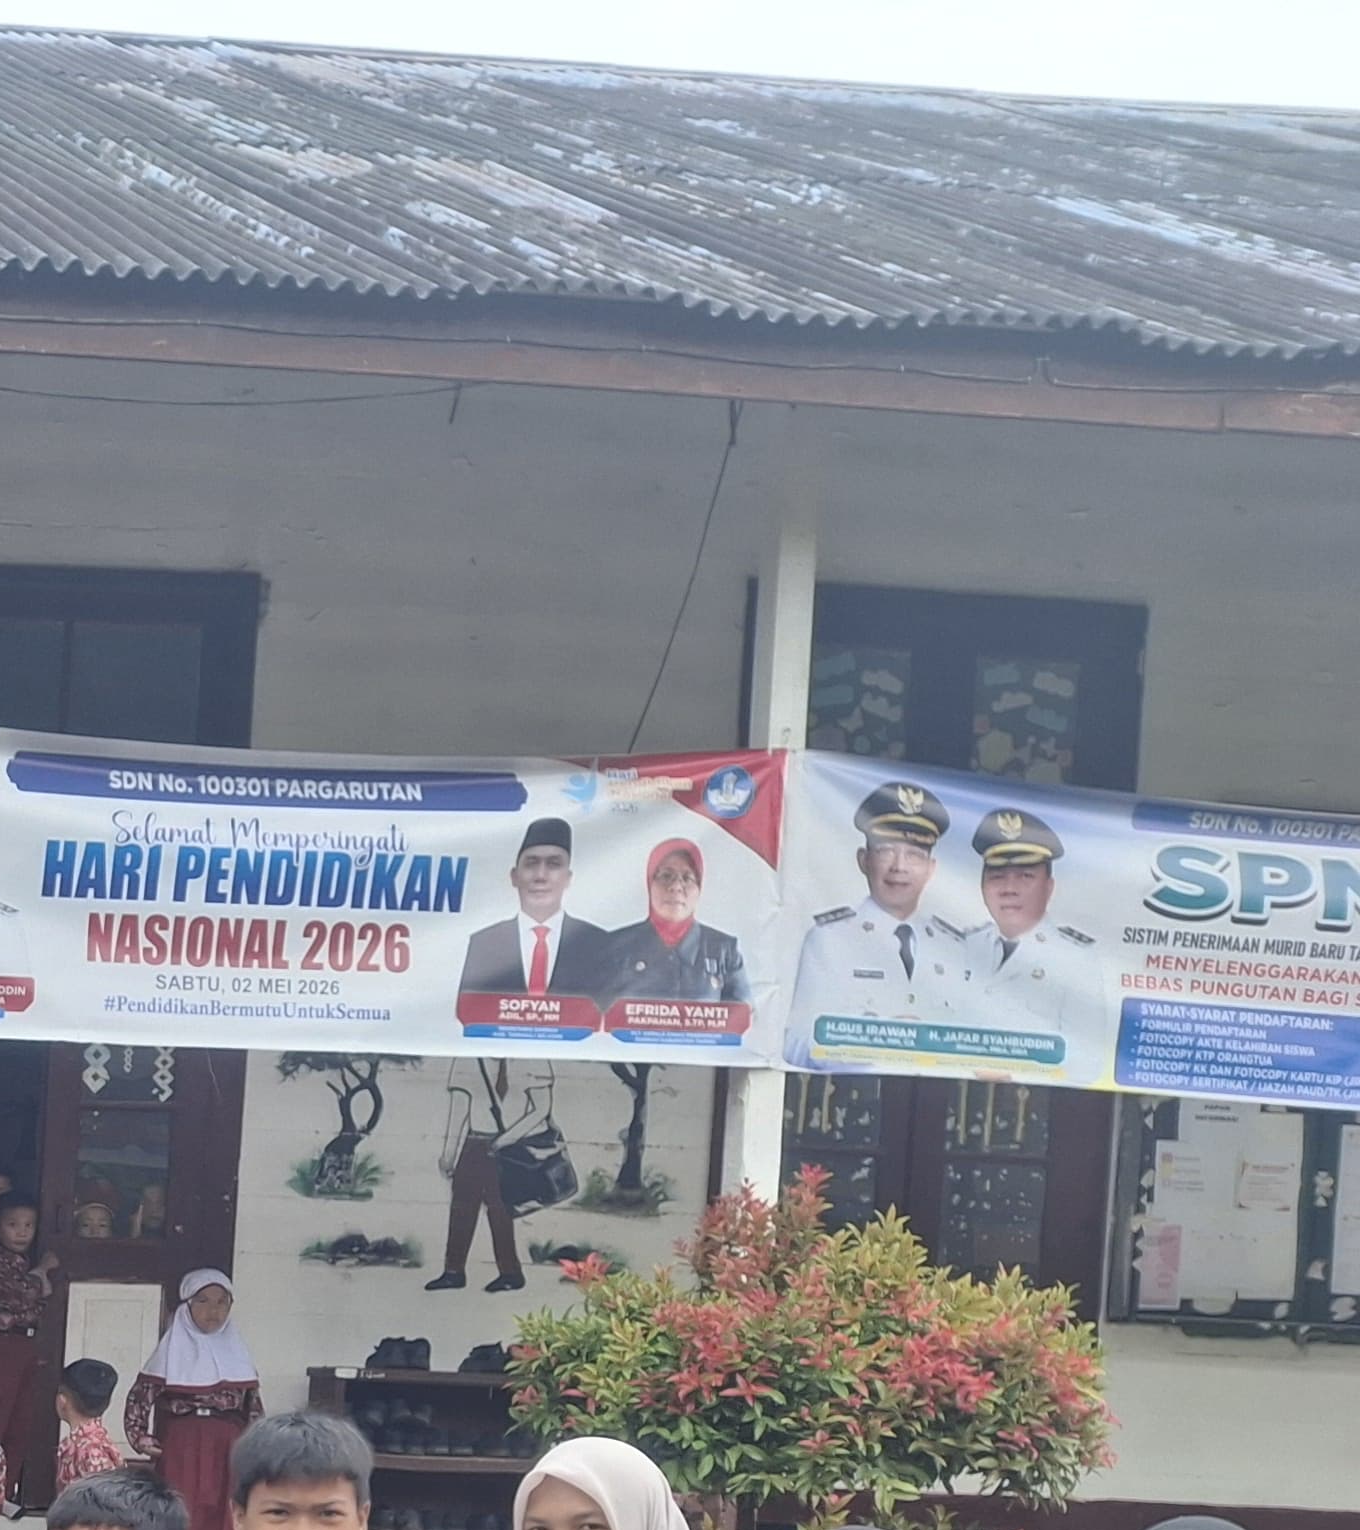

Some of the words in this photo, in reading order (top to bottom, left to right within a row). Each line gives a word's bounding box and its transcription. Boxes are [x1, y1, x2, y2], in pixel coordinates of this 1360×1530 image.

[109, 770, 153, 792] SDN
[159, 773, 193, 794] No.
[199, 775, 269, 797] 100301
[276, 780, 423, 802] PARGARUTAN
[112, 809, 216, 846] Selamat
[1189, 811, 1230, 831] SDN
[1233, 814, 1263, 834] No.
[1270, 818, 1334, 841] 100301
[41, 838, 162, 901] HARI
[86, 912, 289, 971] NASIONAL
[300, 920, 411, 974] 2026
[1122, 926, 1169, 946] SISTIM
[1173, 930, 1261, 955] PENERIMAAN
[1264, 938, 1307, 957] MURID
[1310, 942, 1346, 961] BARU
[1146, 953, 1360, 985] MENYELENGGARAKAN
[155, 974, 226, 995] SABTU,
[231, 977, 254, 994] 02
[259, 978, 292, 995] MEI
[298, 979, 340, 996] 2026
[1121, 972, 1183, 992] BEBAS
[1190, 979, 1297, 1003] PUNGUTAN
[1303, 987, 1350, 1006] BAGI
[103, 995, 391, 1022] #PendidikanBermutuUntukSemua
[499, 999, 561, 1013] SOFYAN
[625, 1003, 681, 1017] EFRIDA
[683, 1005, 729, 1019] YANTI
[1141, 1002, 1237, 1024] SYARAT-SYARAT
[1239, 1012, 1334, 1032] PENDAFTARAN:
[866, 1025, 917, 1039] IRAWAN
[1140, 1018, 1193, 1033] FORMULIR
[1195, 1023, 1267, 1040] PENDAFTARAN
[1137, 1046, 1192, 1061] FOTOCOPY
[1195, 1049, 1216, 1061] KTP
[1217, 1052, 1273, 1067] ORANGTUA
[1138, 1032, 1194, 1047] FOTOCOPY
[1197, 1036, 1224, 1049] AKTE
[1226, 1038, 1282, 1055] KELAHIRAN
[1135, 1059, 1191, 1074] FOTOCOPY
[1209, 1065, 1231, 1077] DAN
[1234, 1066, 1289, 1081] FOTOCOPY
[1290, 1071, 1324, 1084] KARTU
[1135, 1073, 1190, 1089] FOTOCOPY
[1192, 1075, 1248, 1092] SERTIFIKAT
